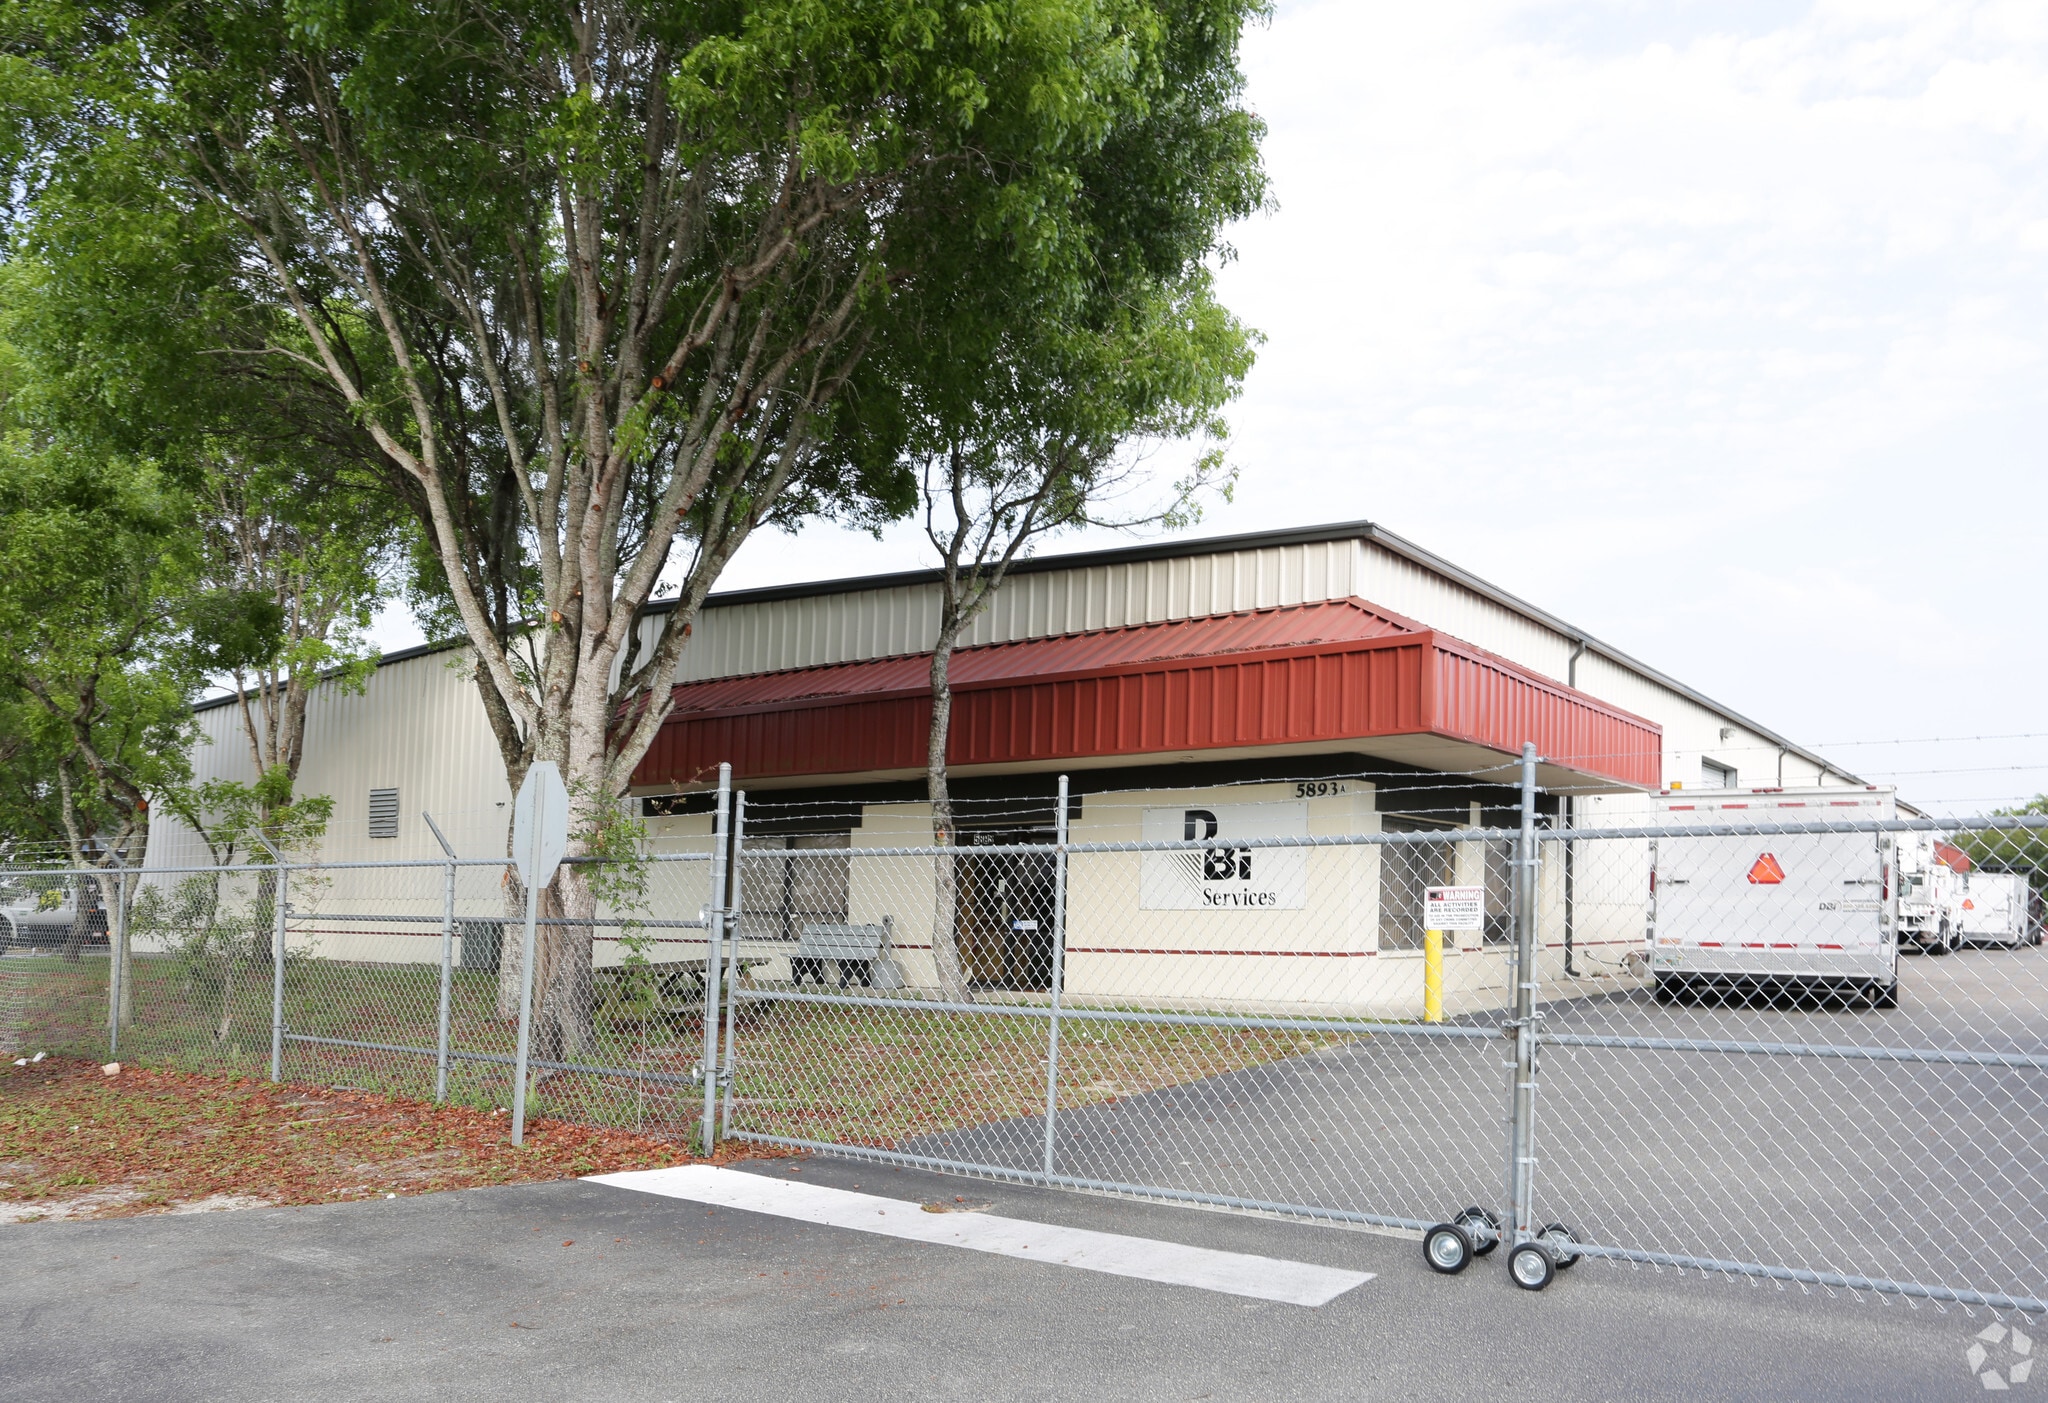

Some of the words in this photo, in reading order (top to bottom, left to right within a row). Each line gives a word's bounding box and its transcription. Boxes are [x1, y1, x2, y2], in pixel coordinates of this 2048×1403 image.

[1295, 782, 1338, 798] 5893
[1202, 888, 1276, 906] Services
[1444, 890, 1480, 900] WARNING
